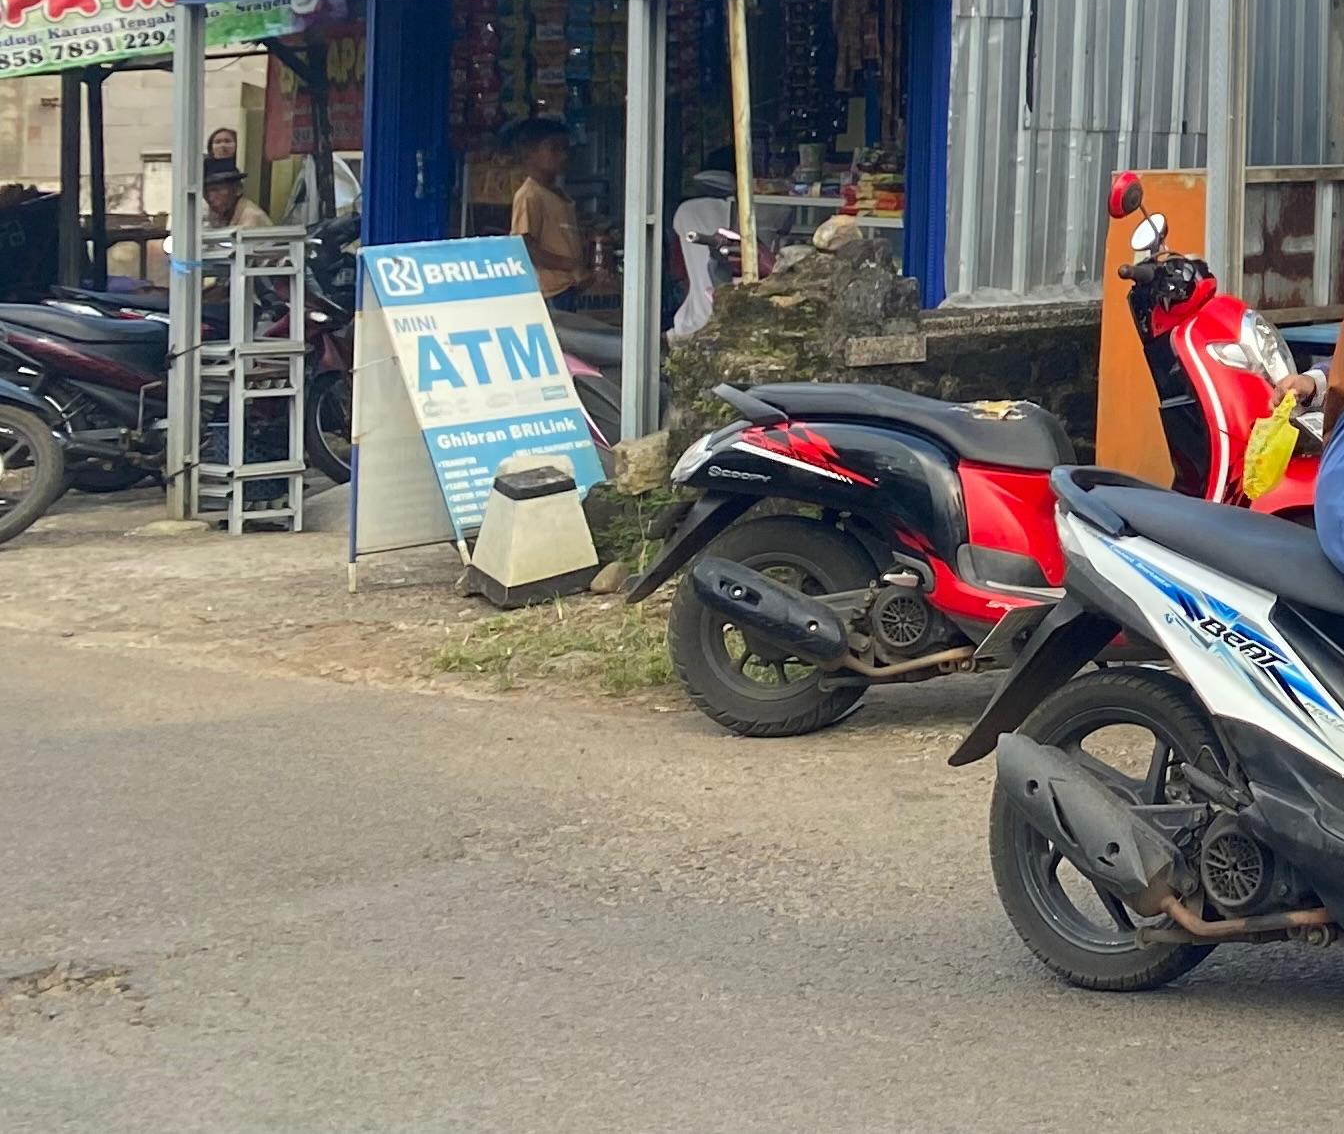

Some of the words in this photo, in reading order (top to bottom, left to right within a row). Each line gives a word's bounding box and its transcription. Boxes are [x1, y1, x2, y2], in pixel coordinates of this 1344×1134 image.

[48, 20, 114, 40] Karang
[115, 12, 176, 32] Tengah
[50, 36, 116, 61] 7891
[422, 257, 527, 284] BRILink
[393, 315, 438, 334] MINI
[416, 323, 561, 393] ATM
[436, 428, 507, 450] Ghibran
[508, 417, 577, 440] BRILink
